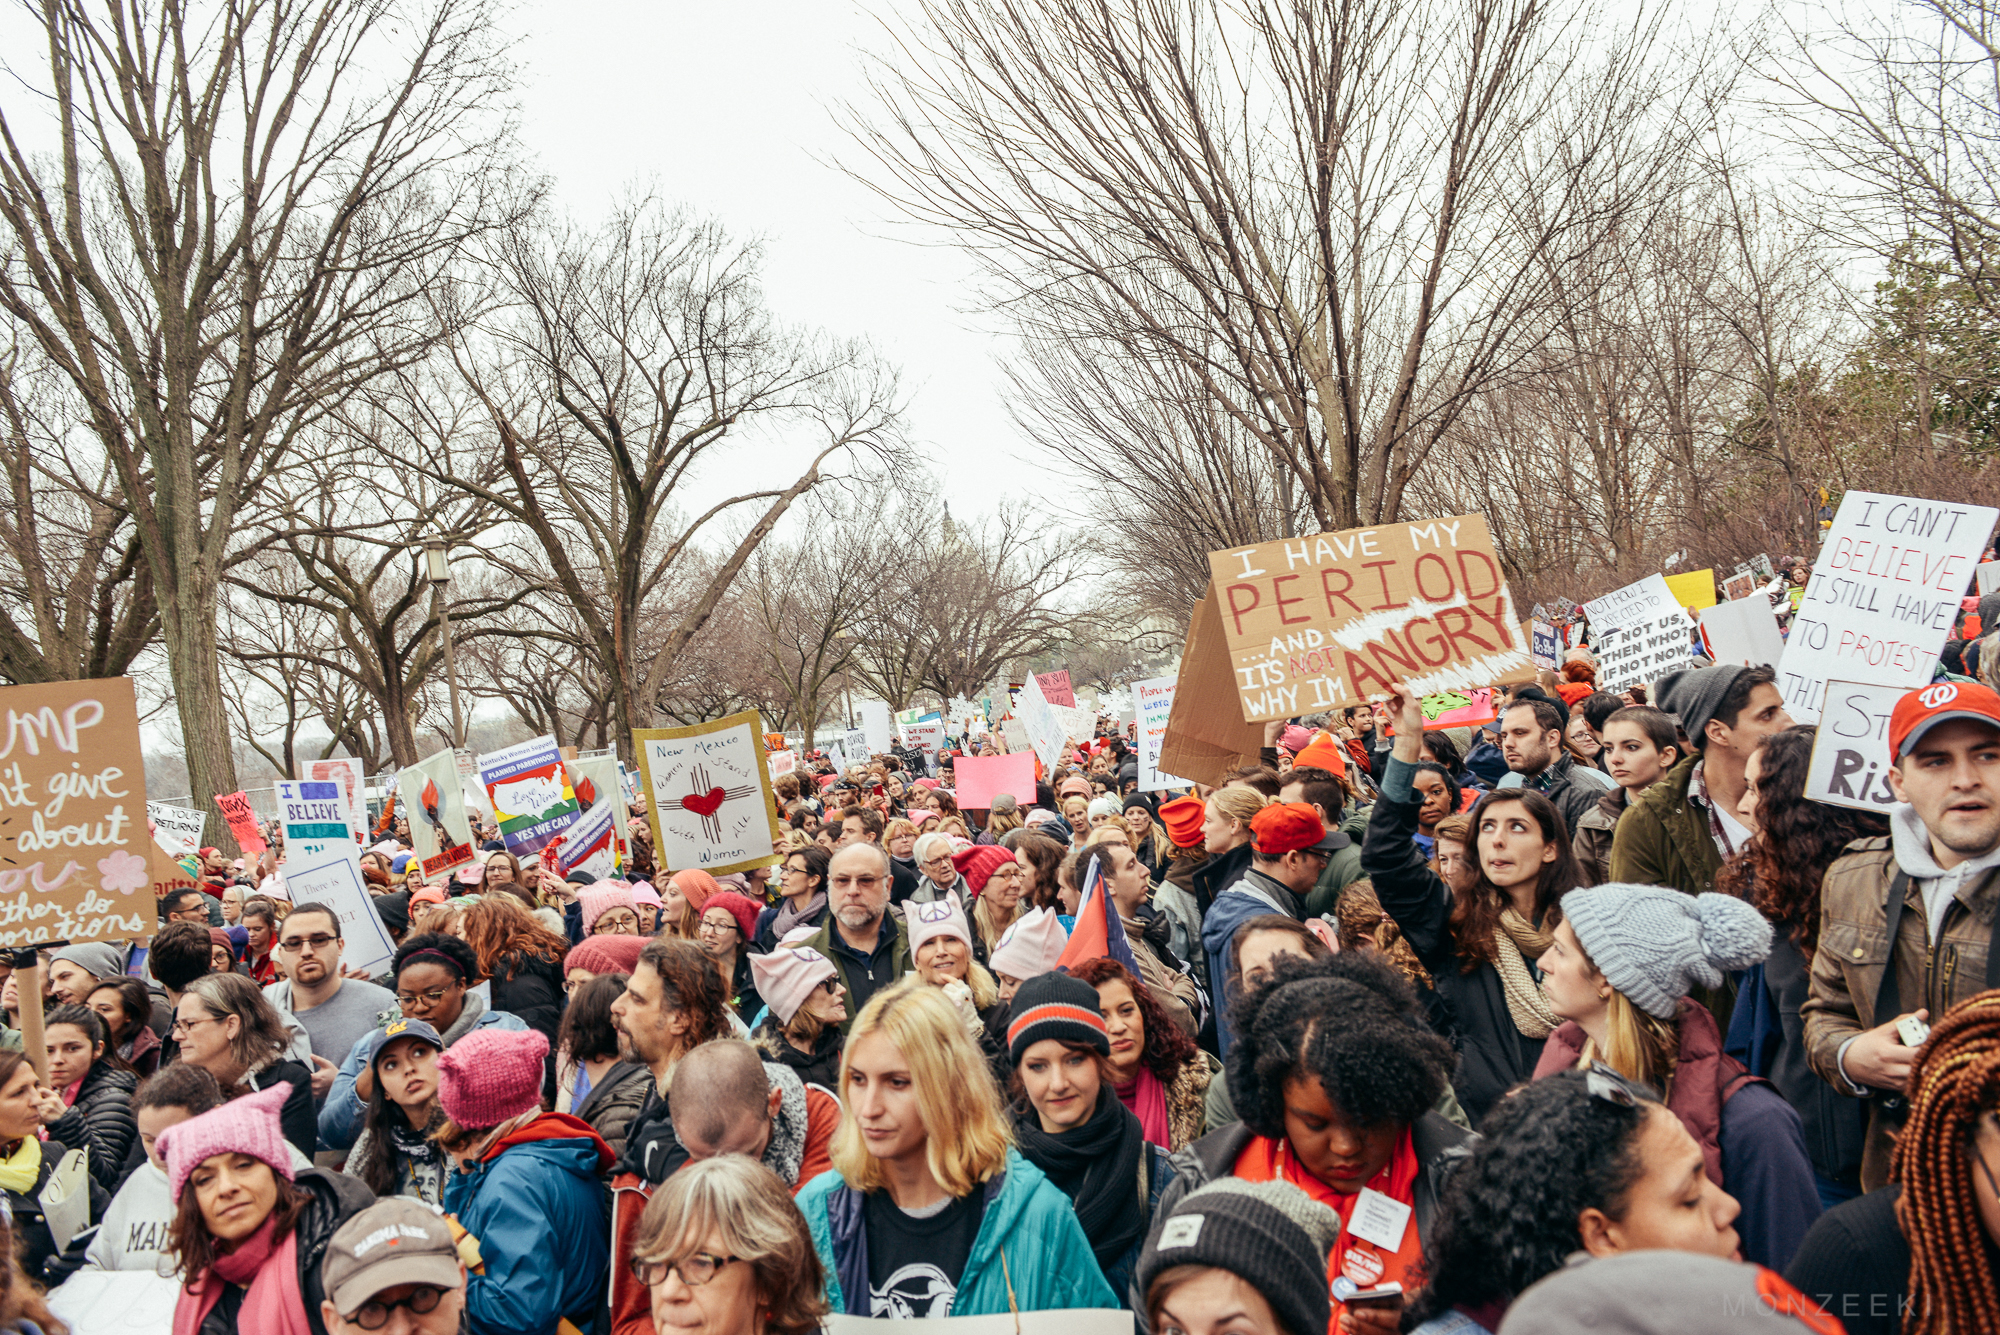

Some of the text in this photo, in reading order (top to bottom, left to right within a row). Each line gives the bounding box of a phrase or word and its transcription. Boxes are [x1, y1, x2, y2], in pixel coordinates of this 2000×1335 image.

[1855, 501, 1967, 543] I CAN'T
[1231, 520, 1461, 579] I HAVE MY
[1830, 536, 1966, 592] BELIEVE
[1226, 550, 1500, 636] PERIOD
[1586, 597, 1611, 617] NOT
[1611, 587, 1637, 606] HOW
[1637, 582, 1649, 594] I
[1806, 573, 1956, 631] I STILL HAVE
[1592, 601, 1645, 633] EXPECTED
[1643, 595, 1661, 608] TO
[1600, 613, 1685, 650] IF NOT US,
[1602, 626, 1688, 665] THEN WHO?
[1244, 683, 1298, 717] WHY
[1306, 673, 1347, 708] I'M
[1344, 596, 1513, 702] ANGRY
[1288, 645, 1338, 679] NOT
[1603, 643, 1692, 681] IF NOT NOW,
[1800, 617, 1939, 679] TO PROTEST
[1140, 685, 1163, 699] PEOPLE
[1144, 699, 1169, 710] LGBTQ
[1785, 672, 1822, 713] THI
[480, 752, 508, 767] Kentucky
[508, 747, 531, 758] Women
[531, 740, 555, 752] Support
[657, 736, 739, 758] New Mexico
[487, 766, 517, 780] PLANNED
[515, 753, 556, 771] PARENTHOOD
[655, 762, 684, 790] Women
[711, 757, 751, 778] Stand
[44, 761, 130, 818] give
[280, 784, 293, 799] I
[512, 788, 536, 806] Love
[528, 790, 558, 809] Wins
[155, 817, 201, 833] RETURNS
[171, 808, 201, 822] YOUR
[287, 803, 341, 821] BELIEVE
[17, 805, 130, 853] about
[514, 814, 572, 843] YES WE CAN
[424, 856, 441, 873] HEAR
[452, 844, 471, 861] VOICE
[698, 847, 746, 864] Women
[302, 877, 340, 895] There is
[75, 889, 115, 916] do
[385, 1020, 408, 1037] Cal
